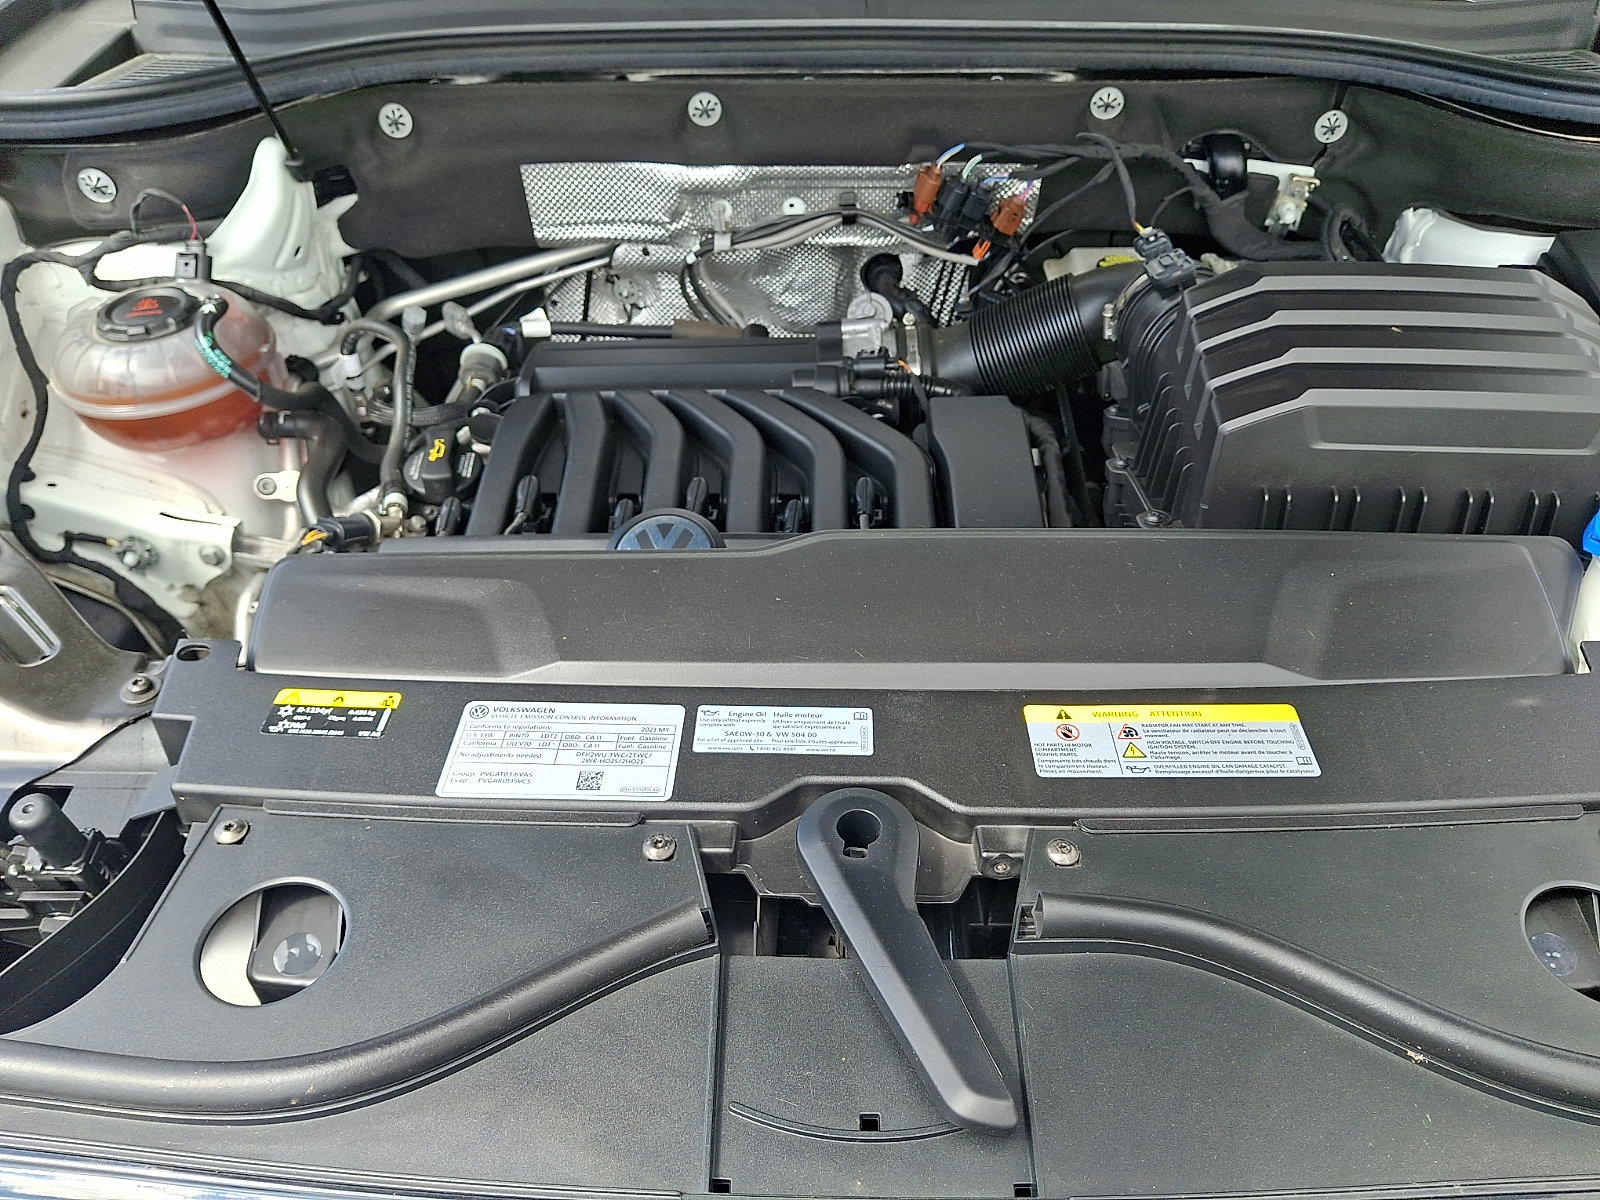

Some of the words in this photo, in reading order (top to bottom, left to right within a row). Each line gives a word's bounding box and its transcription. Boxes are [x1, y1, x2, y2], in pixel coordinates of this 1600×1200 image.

[493, 706, 556, 714] VOLKSWAGEN
[728, 711, 754, 719] Engine
[1092, 711, 1139, 719] WARNING
[1150, 710, 1202, 718] ATTENTION
